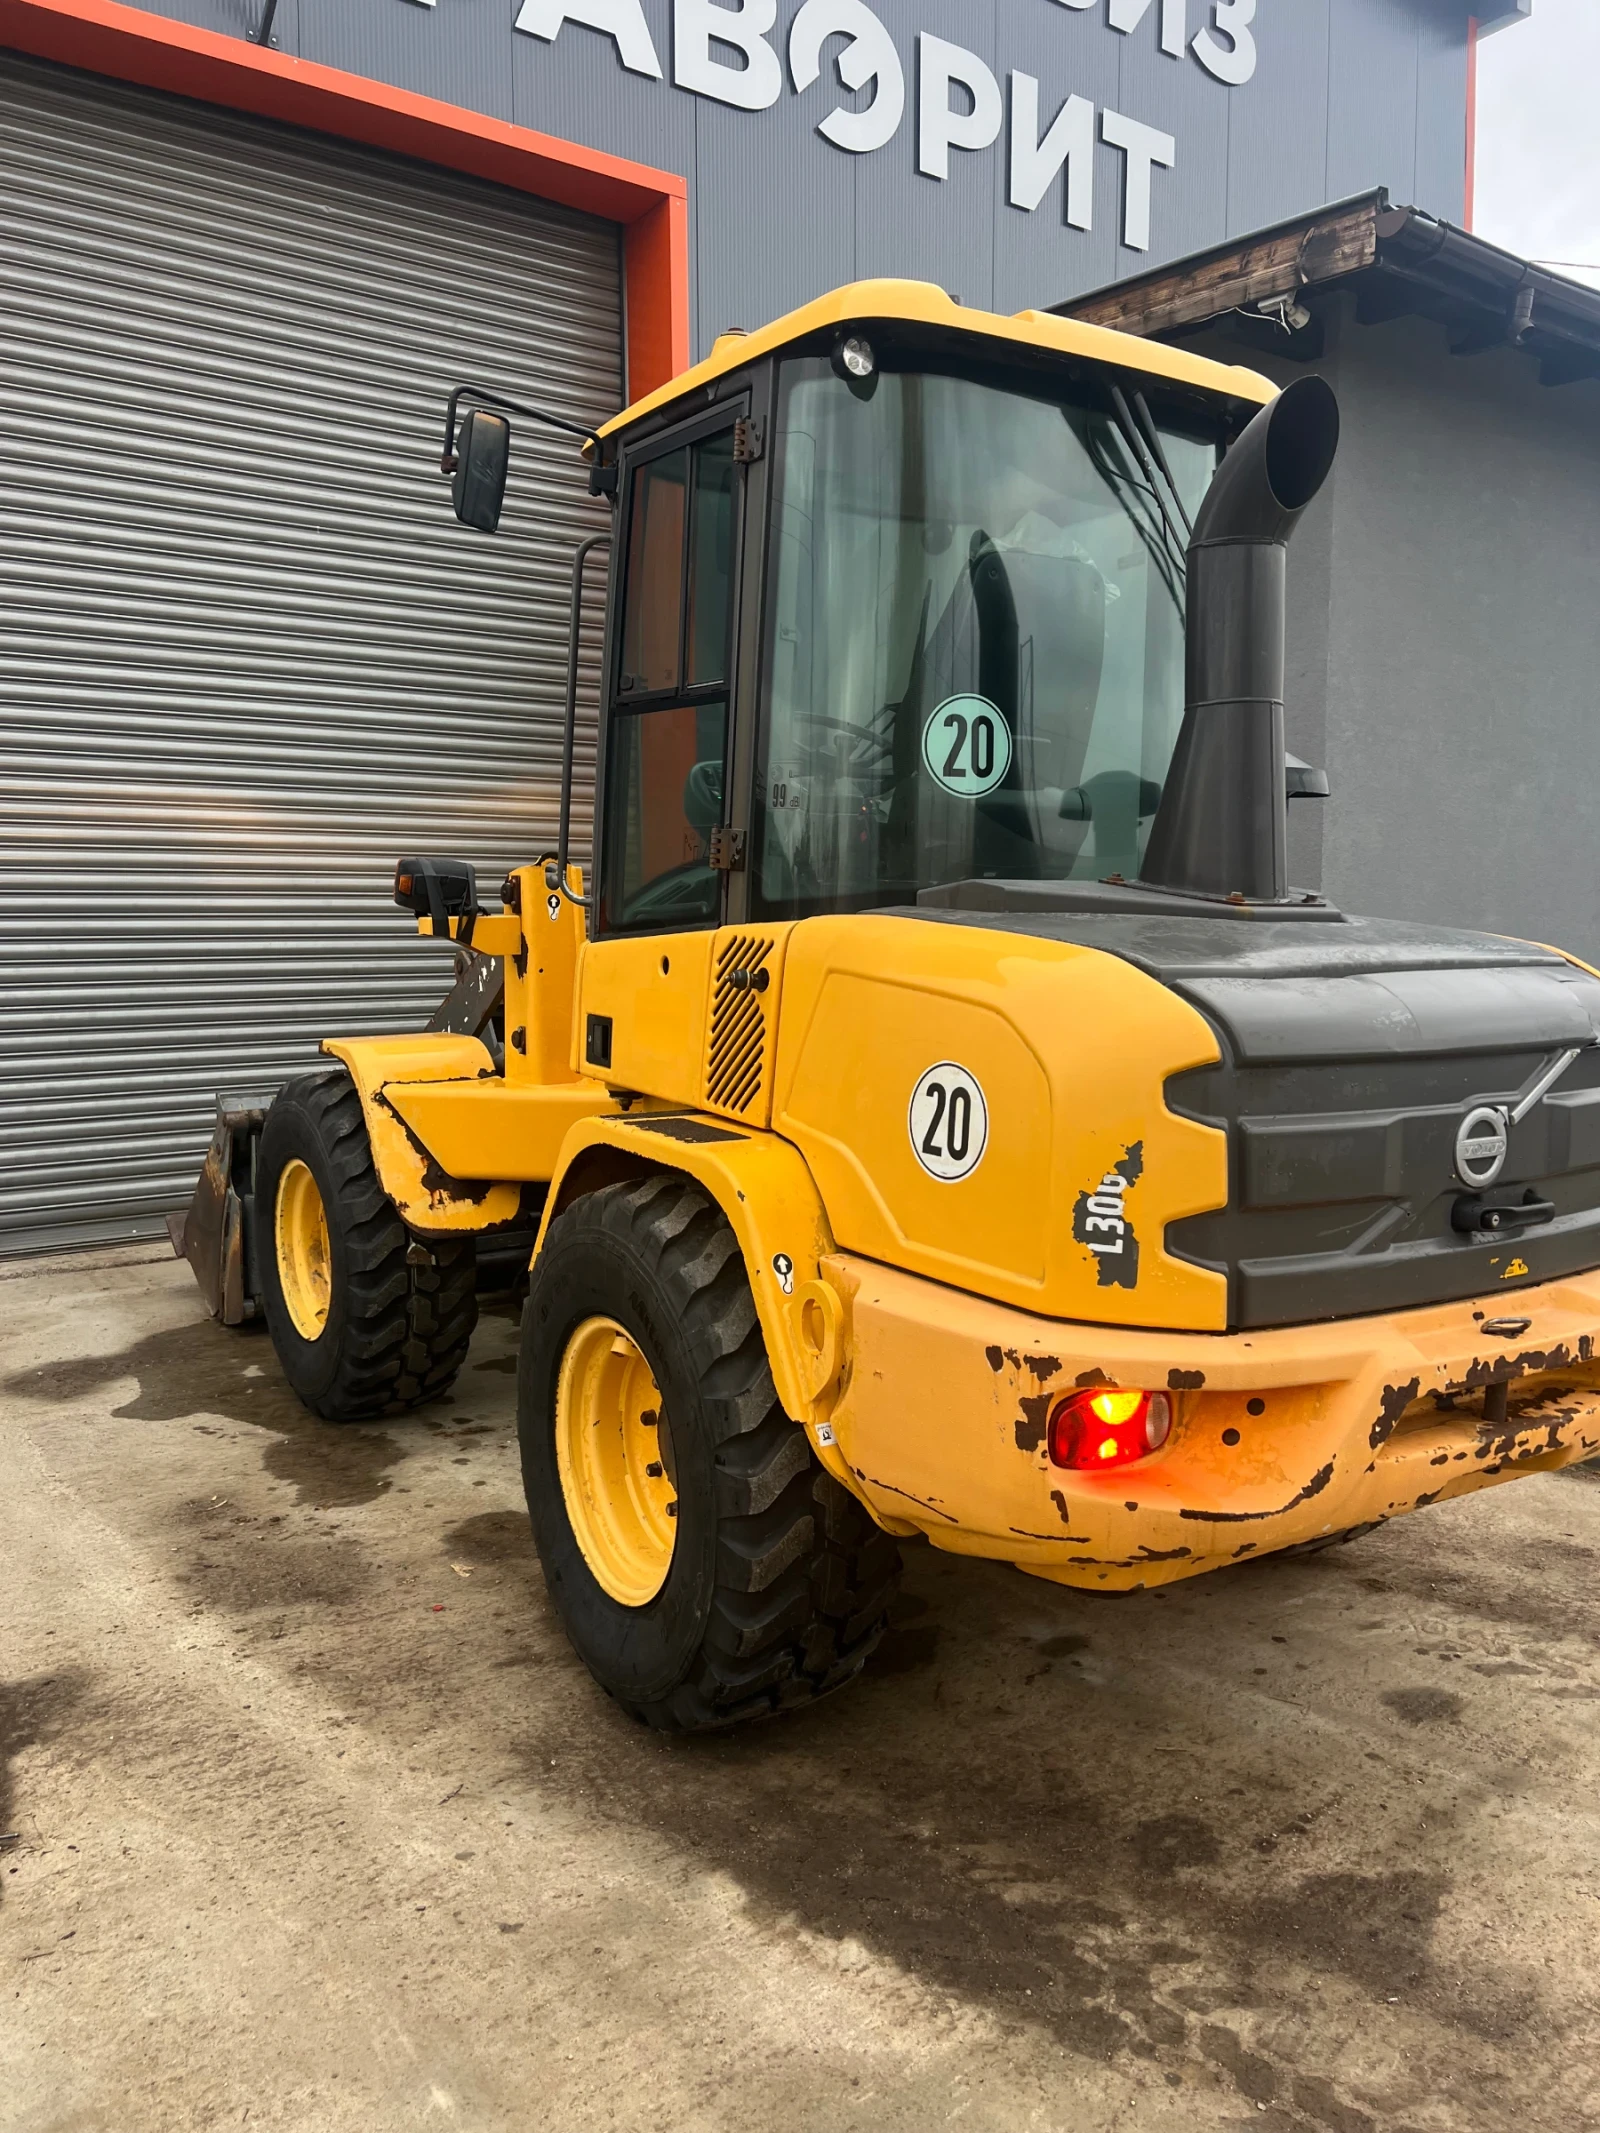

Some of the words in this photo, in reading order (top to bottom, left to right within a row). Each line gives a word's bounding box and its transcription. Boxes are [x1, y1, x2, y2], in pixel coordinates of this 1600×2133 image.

[942, 713, 995, 779] 20
[772, 783, 786, 808] 99
[922, 1082, 971, 1161] 20
